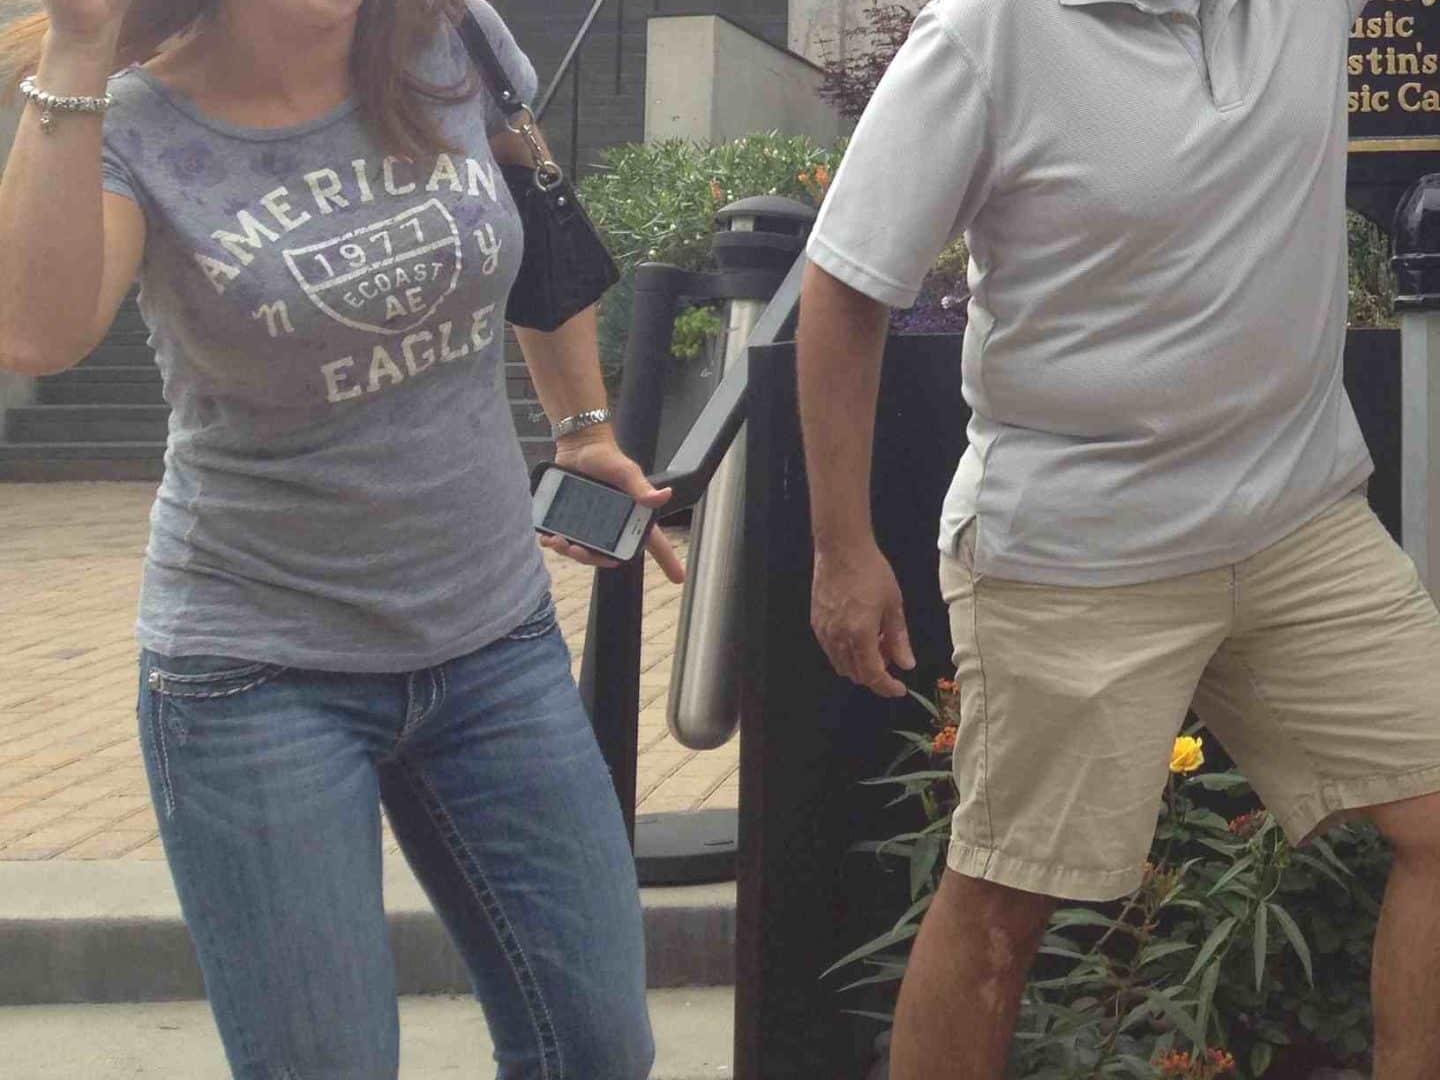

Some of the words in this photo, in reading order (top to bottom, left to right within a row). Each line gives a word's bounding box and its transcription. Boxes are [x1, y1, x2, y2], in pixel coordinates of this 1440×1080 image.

[1349, 9, 1415, 39] usic
[1348, 41, 1438, 76] stin's
[1348, 83, 1390, 113] sic
[194, 152, 498, 295] AMERICAN
[313, 217, 424, 278] 1977
[384, 286, 428, 320] AE
[320, 303, 497, 404] EAGLE
